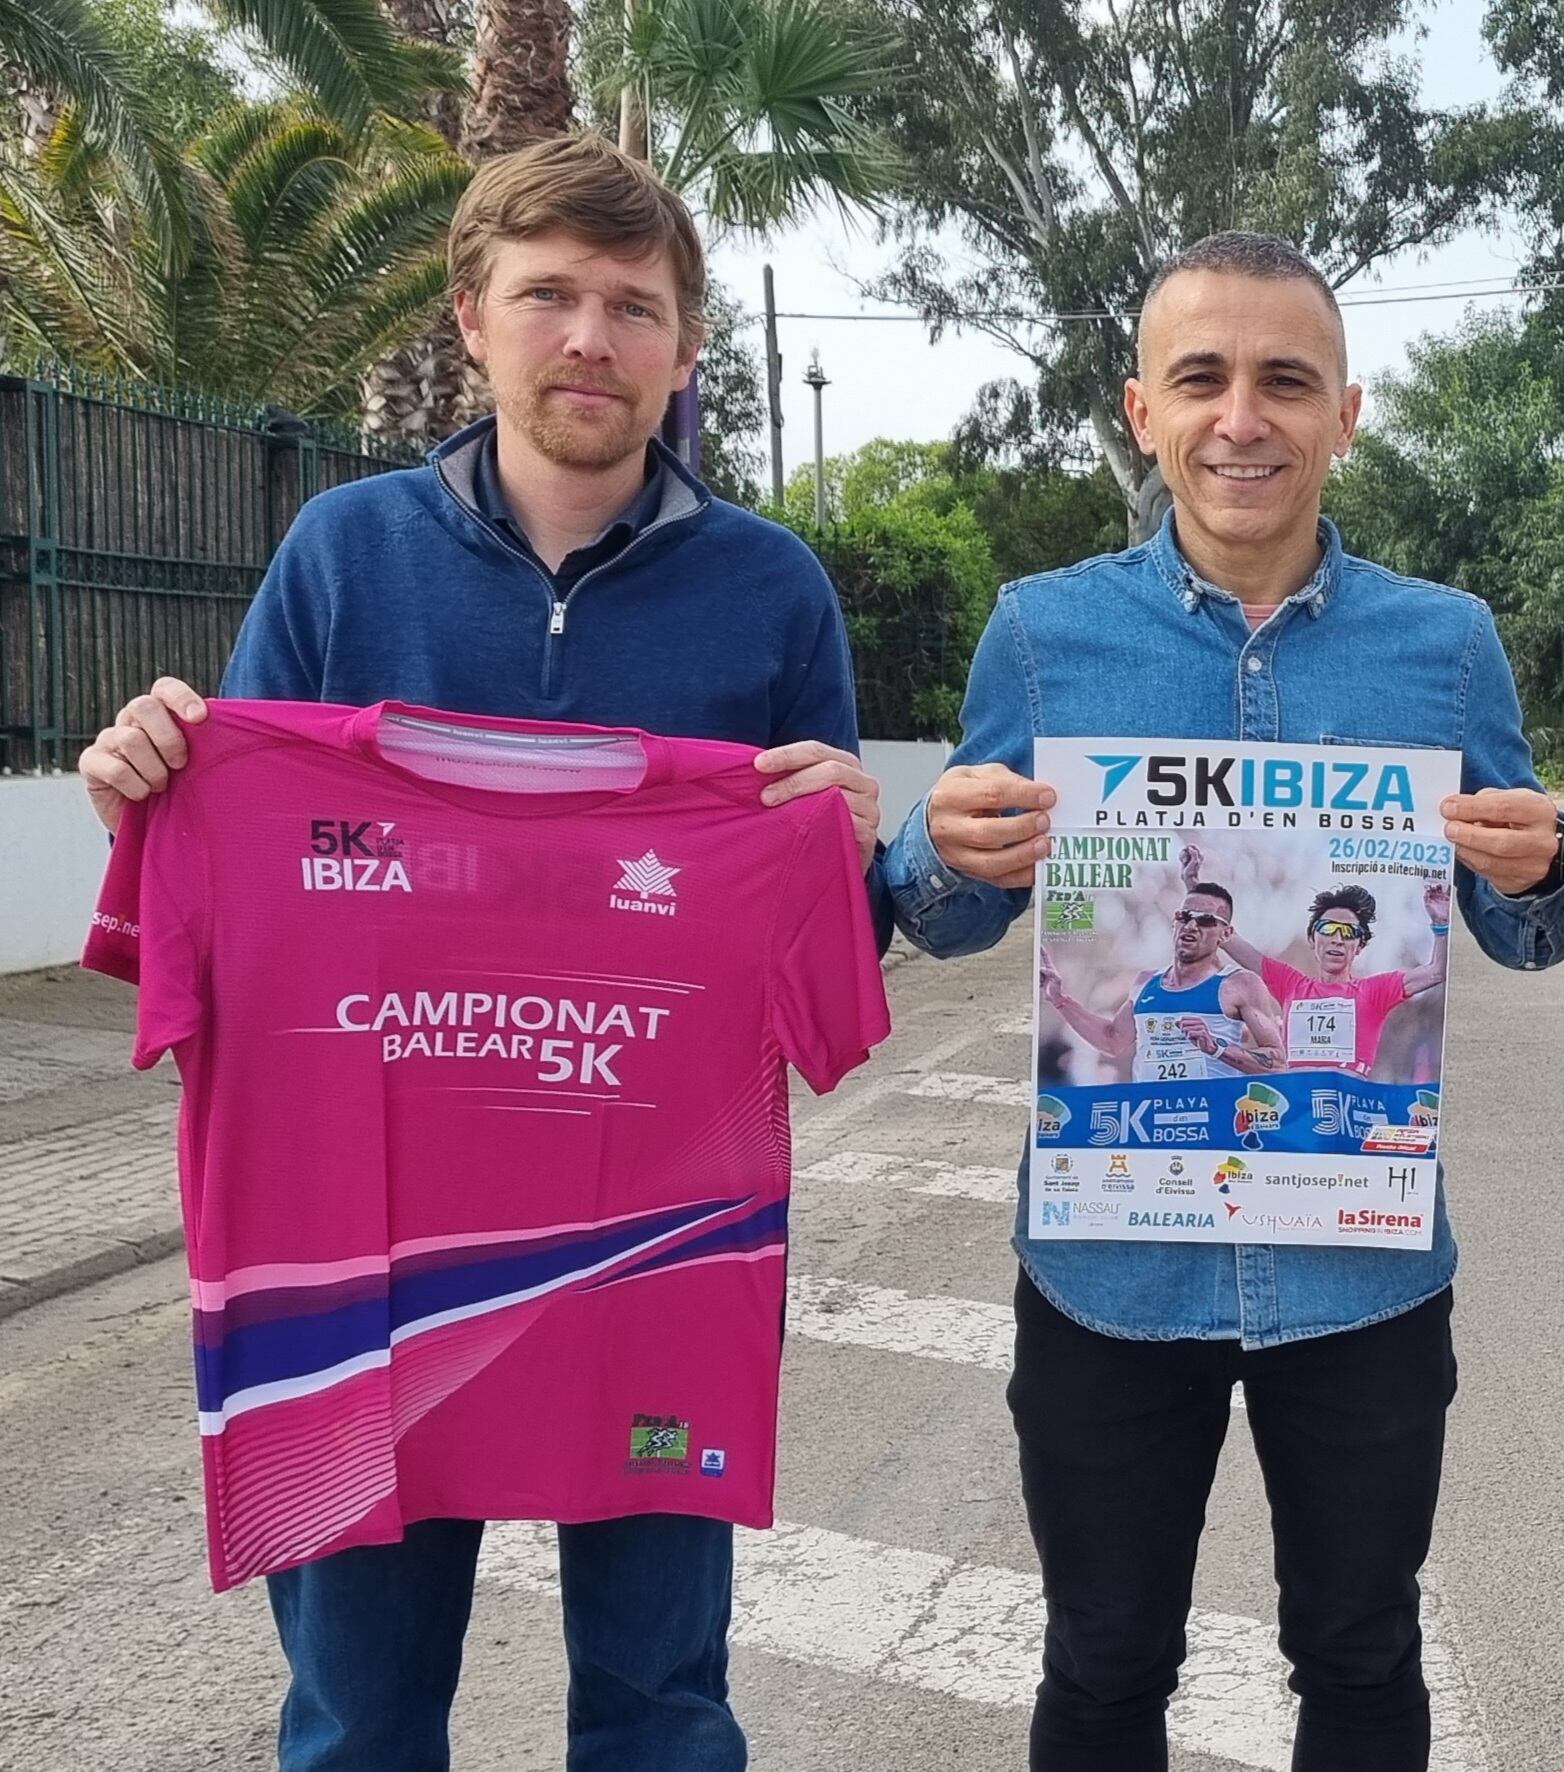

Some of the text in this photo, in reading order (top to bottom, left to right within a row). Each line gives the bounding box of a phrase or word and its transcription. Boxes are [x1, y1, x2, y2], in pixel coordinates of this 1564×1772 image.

[1096, 811, 1415, 832] PLATJA D'EN BOSSA
[310, 819, 377, 857] 5K
[1046, 836, 1171, 861] CAMPIONAT
[1329, 837, 1451, 865] 26/02/2023
[301, 857, 412, 892] IBIZA
[1046, 863, 1133, 888] BALEAR
[1331, 861, 1447, 880] Inscripció a elitechip.net
[609, 894, 677, 916] luanvi
[336, 991, 670, 1040] CAMPIONAT
[1306, 1015, 1336, 1032] 174
[383, 1031, 623, 1086] BALEAR 5K
[1157, 1062, 1187, 1081] 242
[1153, 1096, 1209, 1111] PLAYA
[1351, 1095, 1386, 1111] PLAYA
[1087, 1099, 1152, 1147] 5K
[1240, 1108, 1279, 1124] Ibiza
[1310, 1088, 1354, 1139] 5K
[1038, 1119, 1061, 1132] iza
[1153, 1126, 1210, 1143] BOSSA
[1155, 1186, 1195, 1195] d'Eivissa
[1158, 1178, 1193, 1187] Consell
[1072, 1202, 1120, 1214] NASSAU
